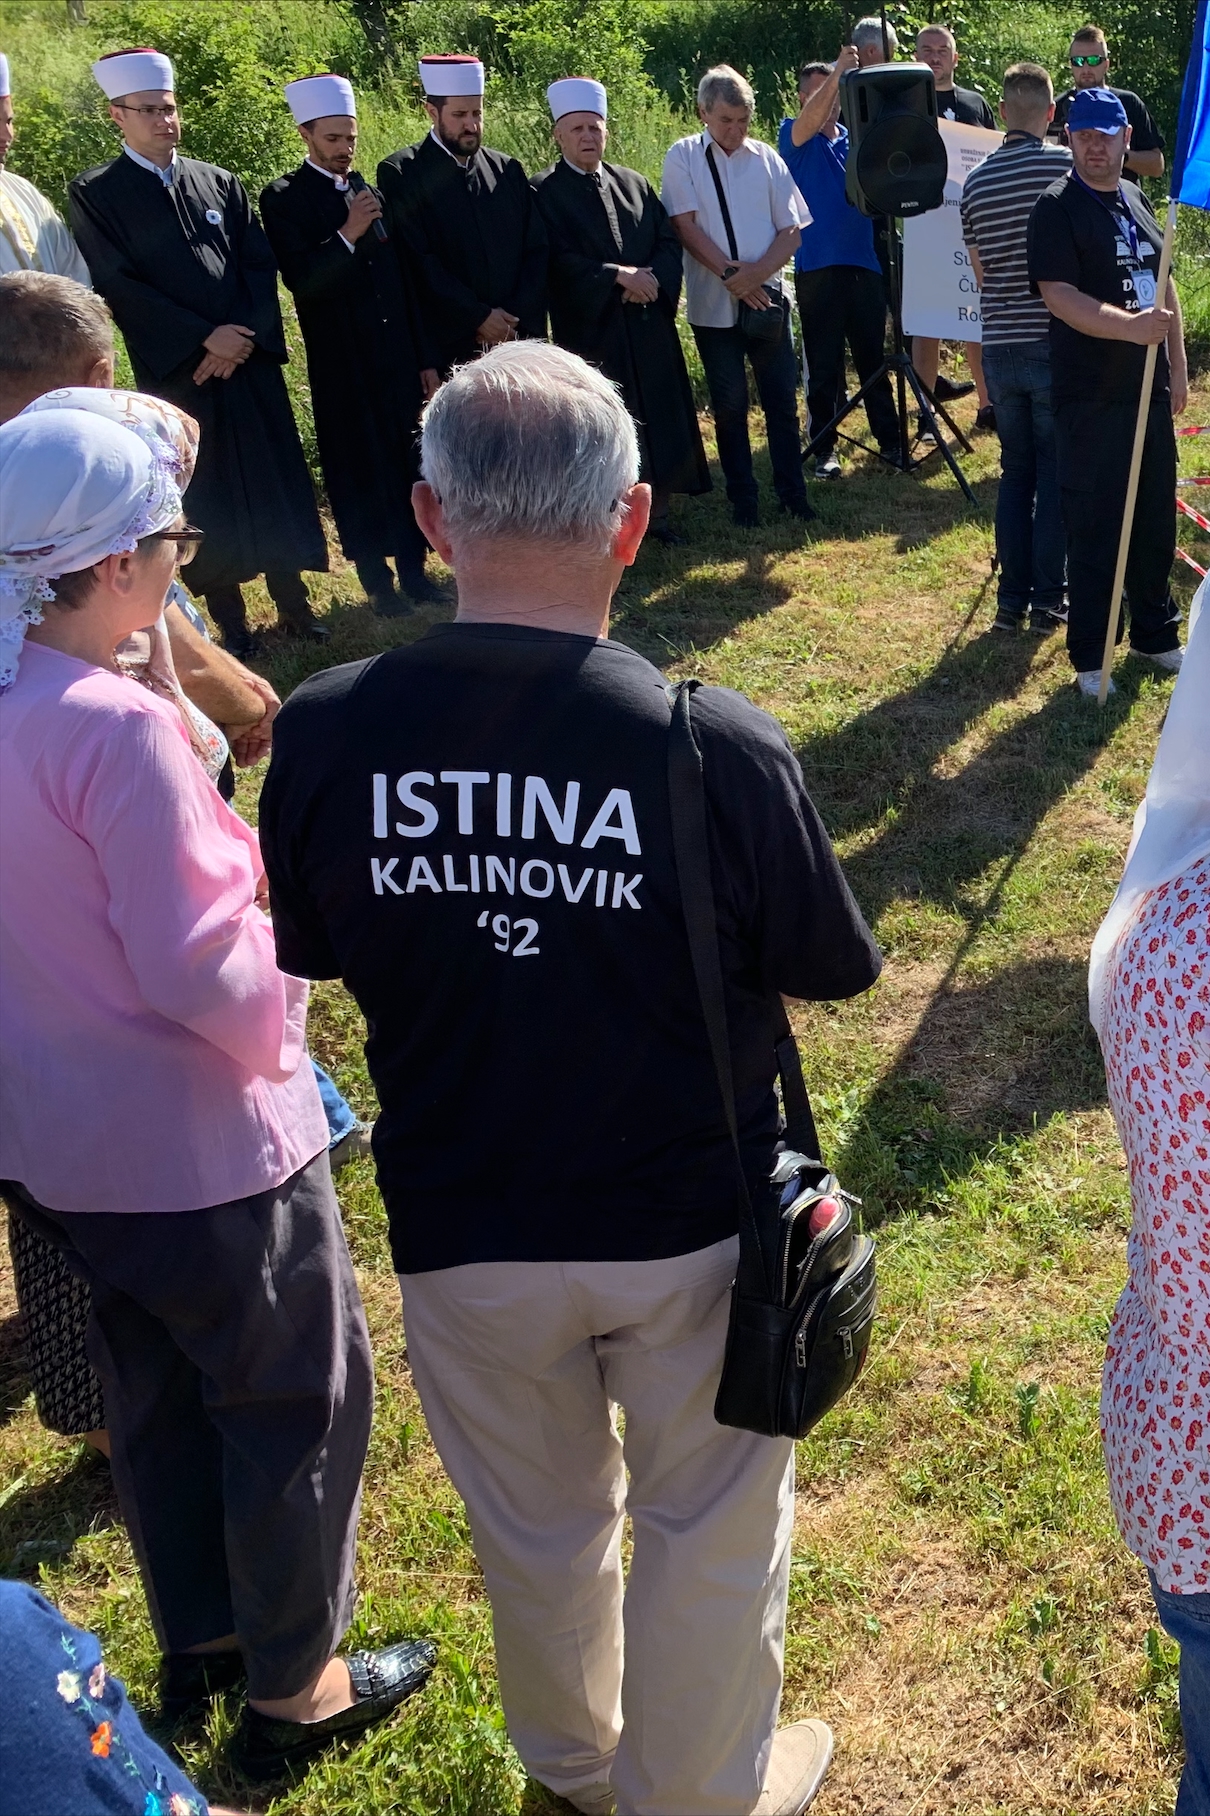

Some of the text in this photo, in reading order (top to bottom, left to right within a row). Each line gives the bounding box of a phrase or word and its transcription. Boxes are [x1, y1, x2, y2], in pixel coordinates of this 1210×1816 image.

[953, 251, 972, 266] Su
[959, 274, 980, 294] Ču
[1125, 300, 1140, 310] za
[372, 770, 642, 856] ISTINA
[370, 854, 643, 910] KALINOVIK
